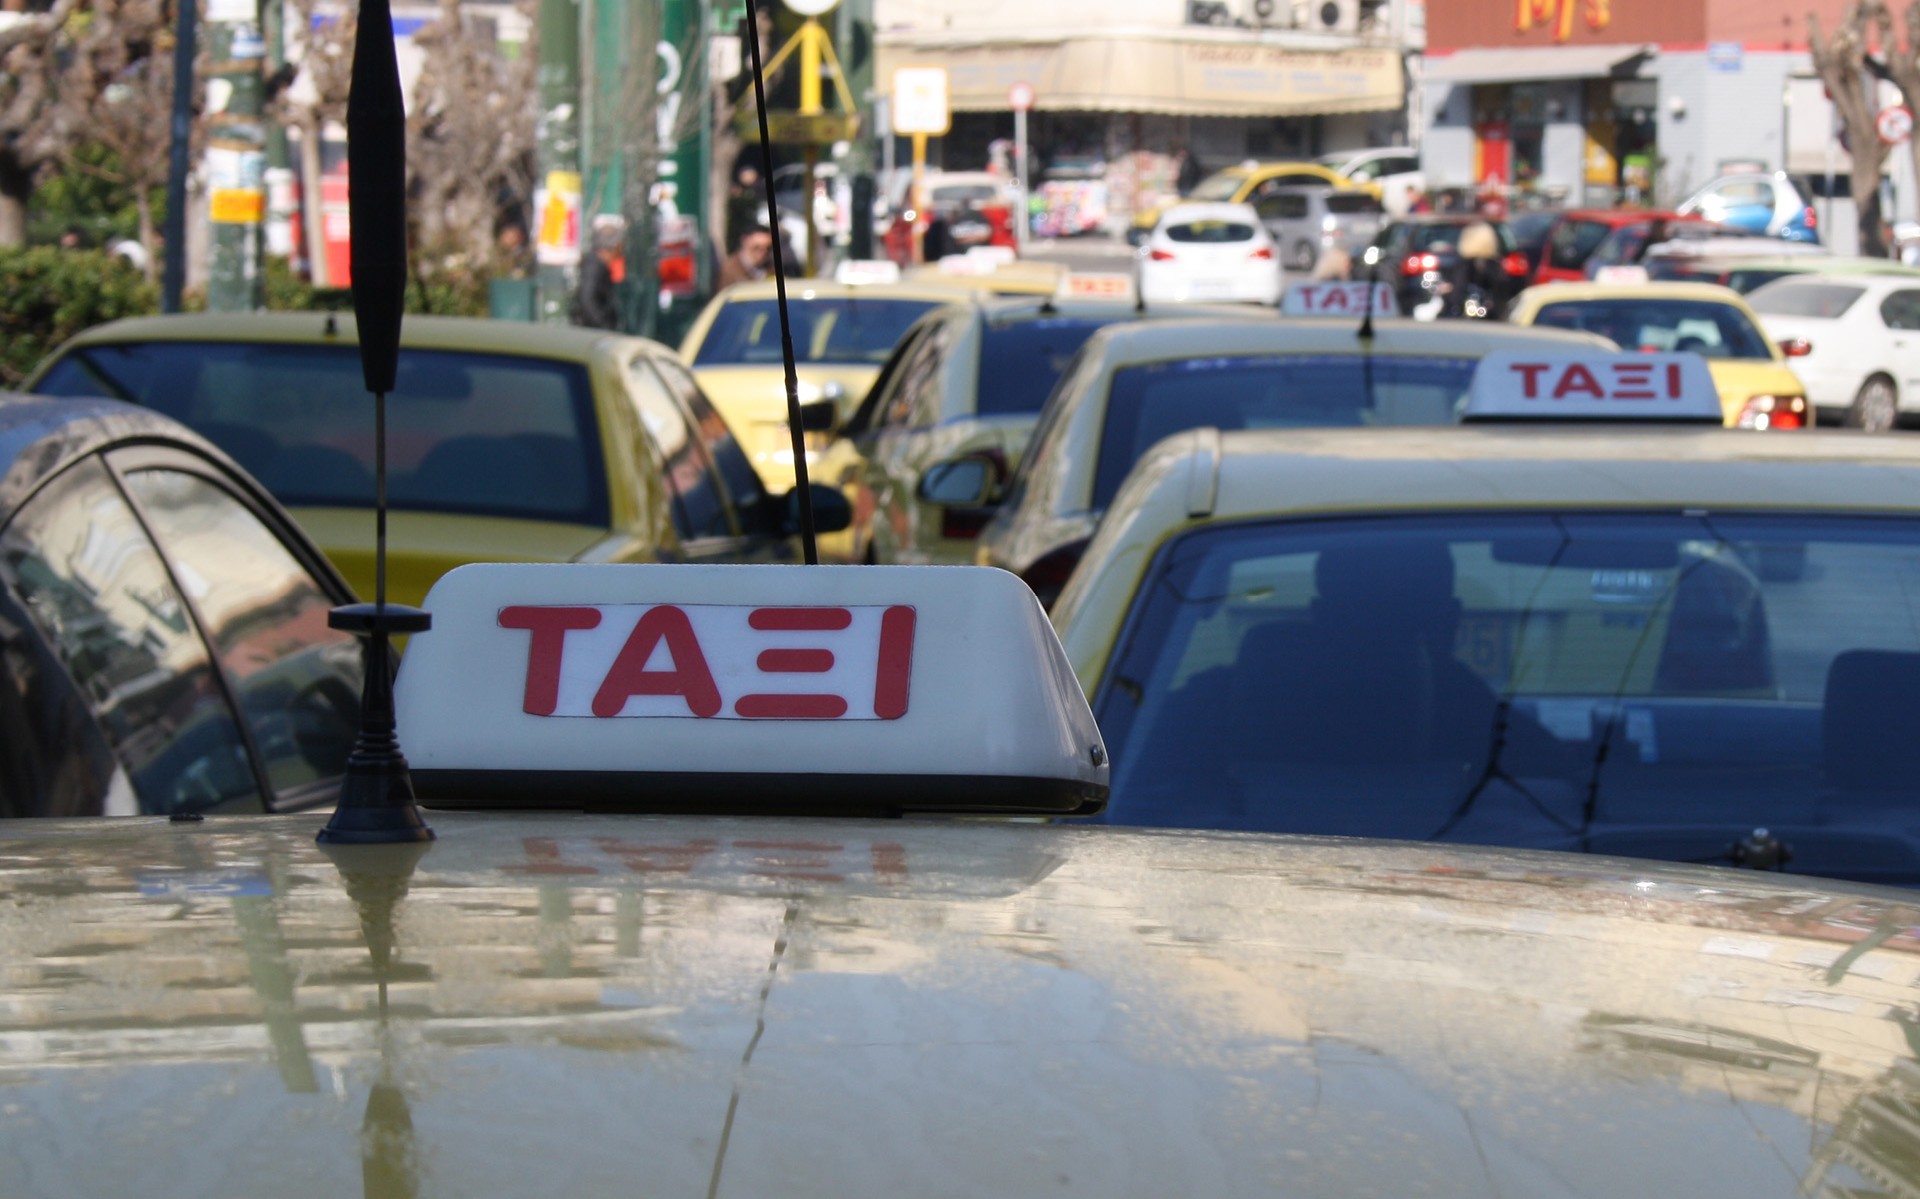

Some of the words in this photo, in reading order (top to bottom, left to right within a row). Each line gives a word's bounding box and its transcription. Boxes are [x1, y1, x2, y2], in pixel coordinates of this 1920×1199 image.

[1297, 286, 1390, 311] ΤΑΞΙ
[1510, 362, 1682, 399] ΤΑΞΙ
[498, 604, 916, 719] ΤΑΞΙ
